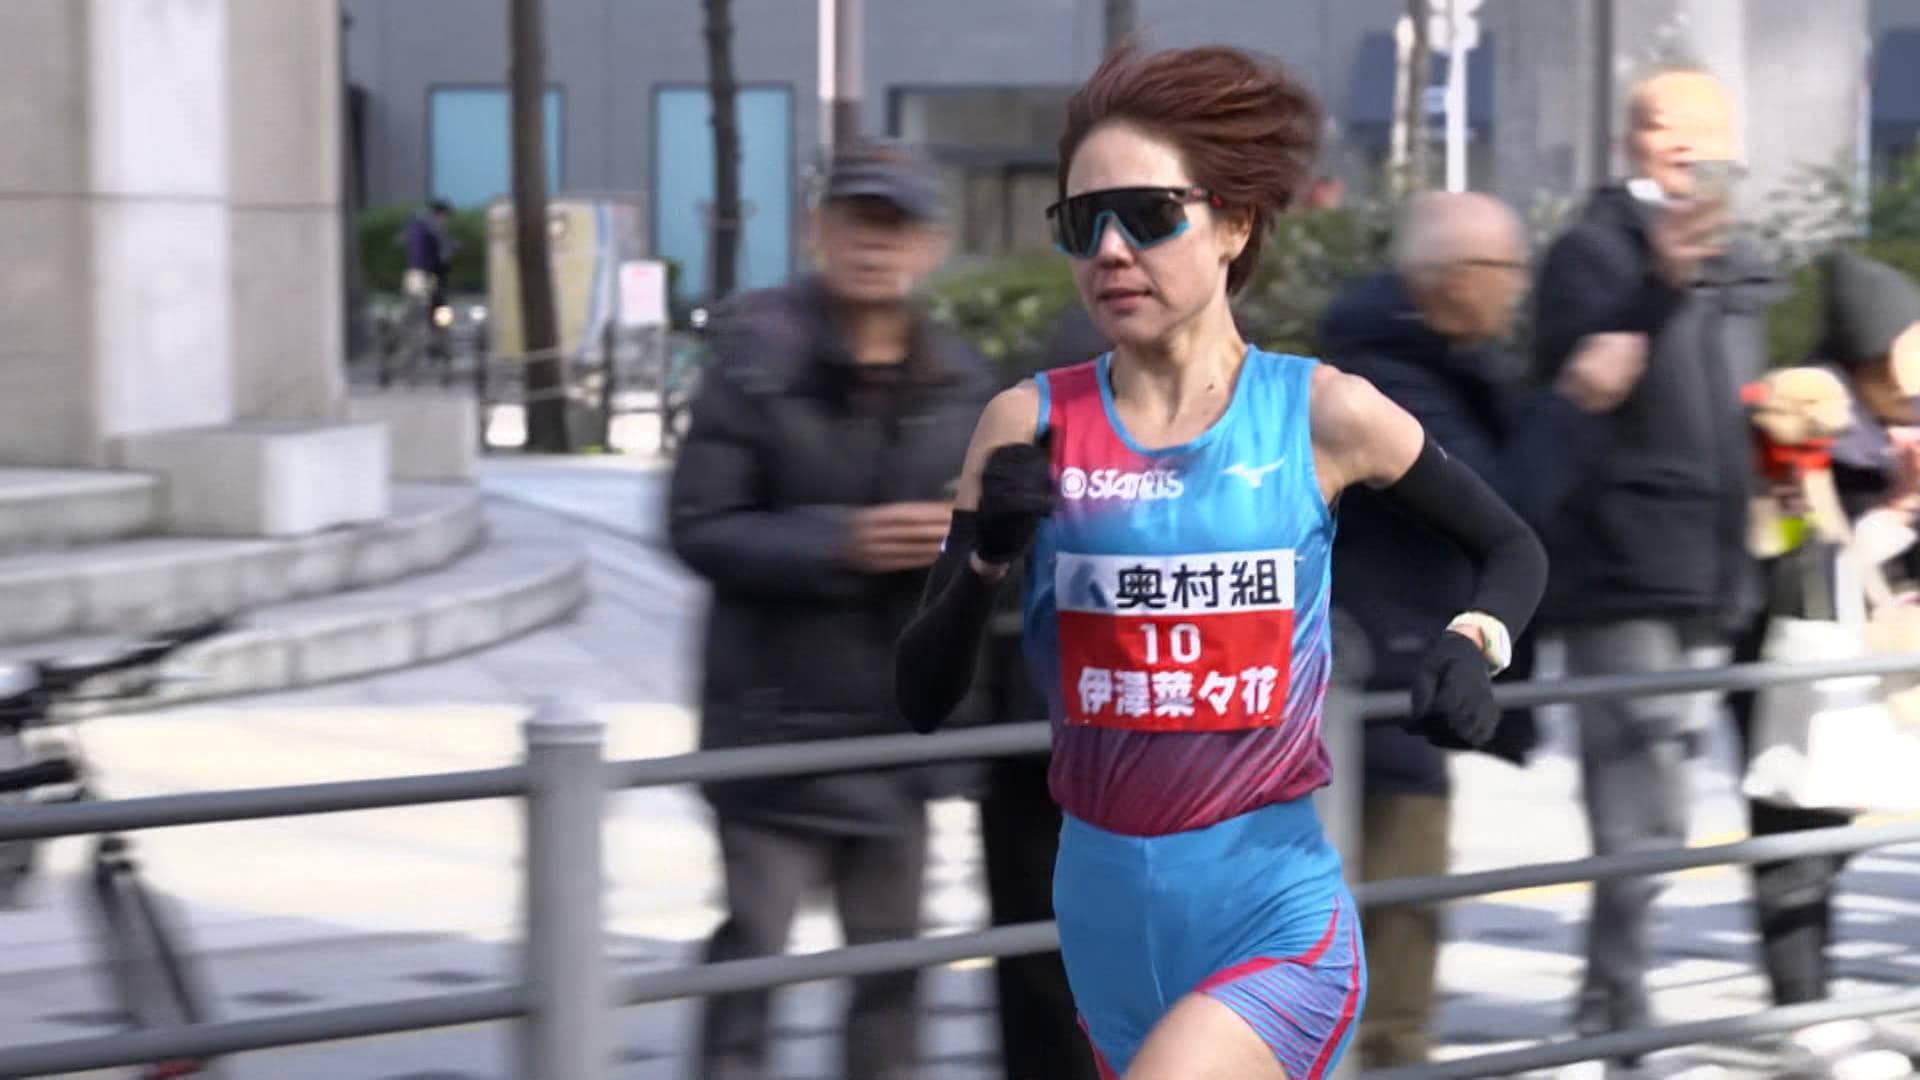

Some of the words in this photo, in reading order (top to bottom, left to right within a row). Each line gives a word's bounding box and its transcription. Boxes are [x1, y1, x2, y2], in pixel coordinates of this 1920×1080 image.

[1115, 559, 1281, 608] 奥村組
[1140, 623, 1202, 664] 10
